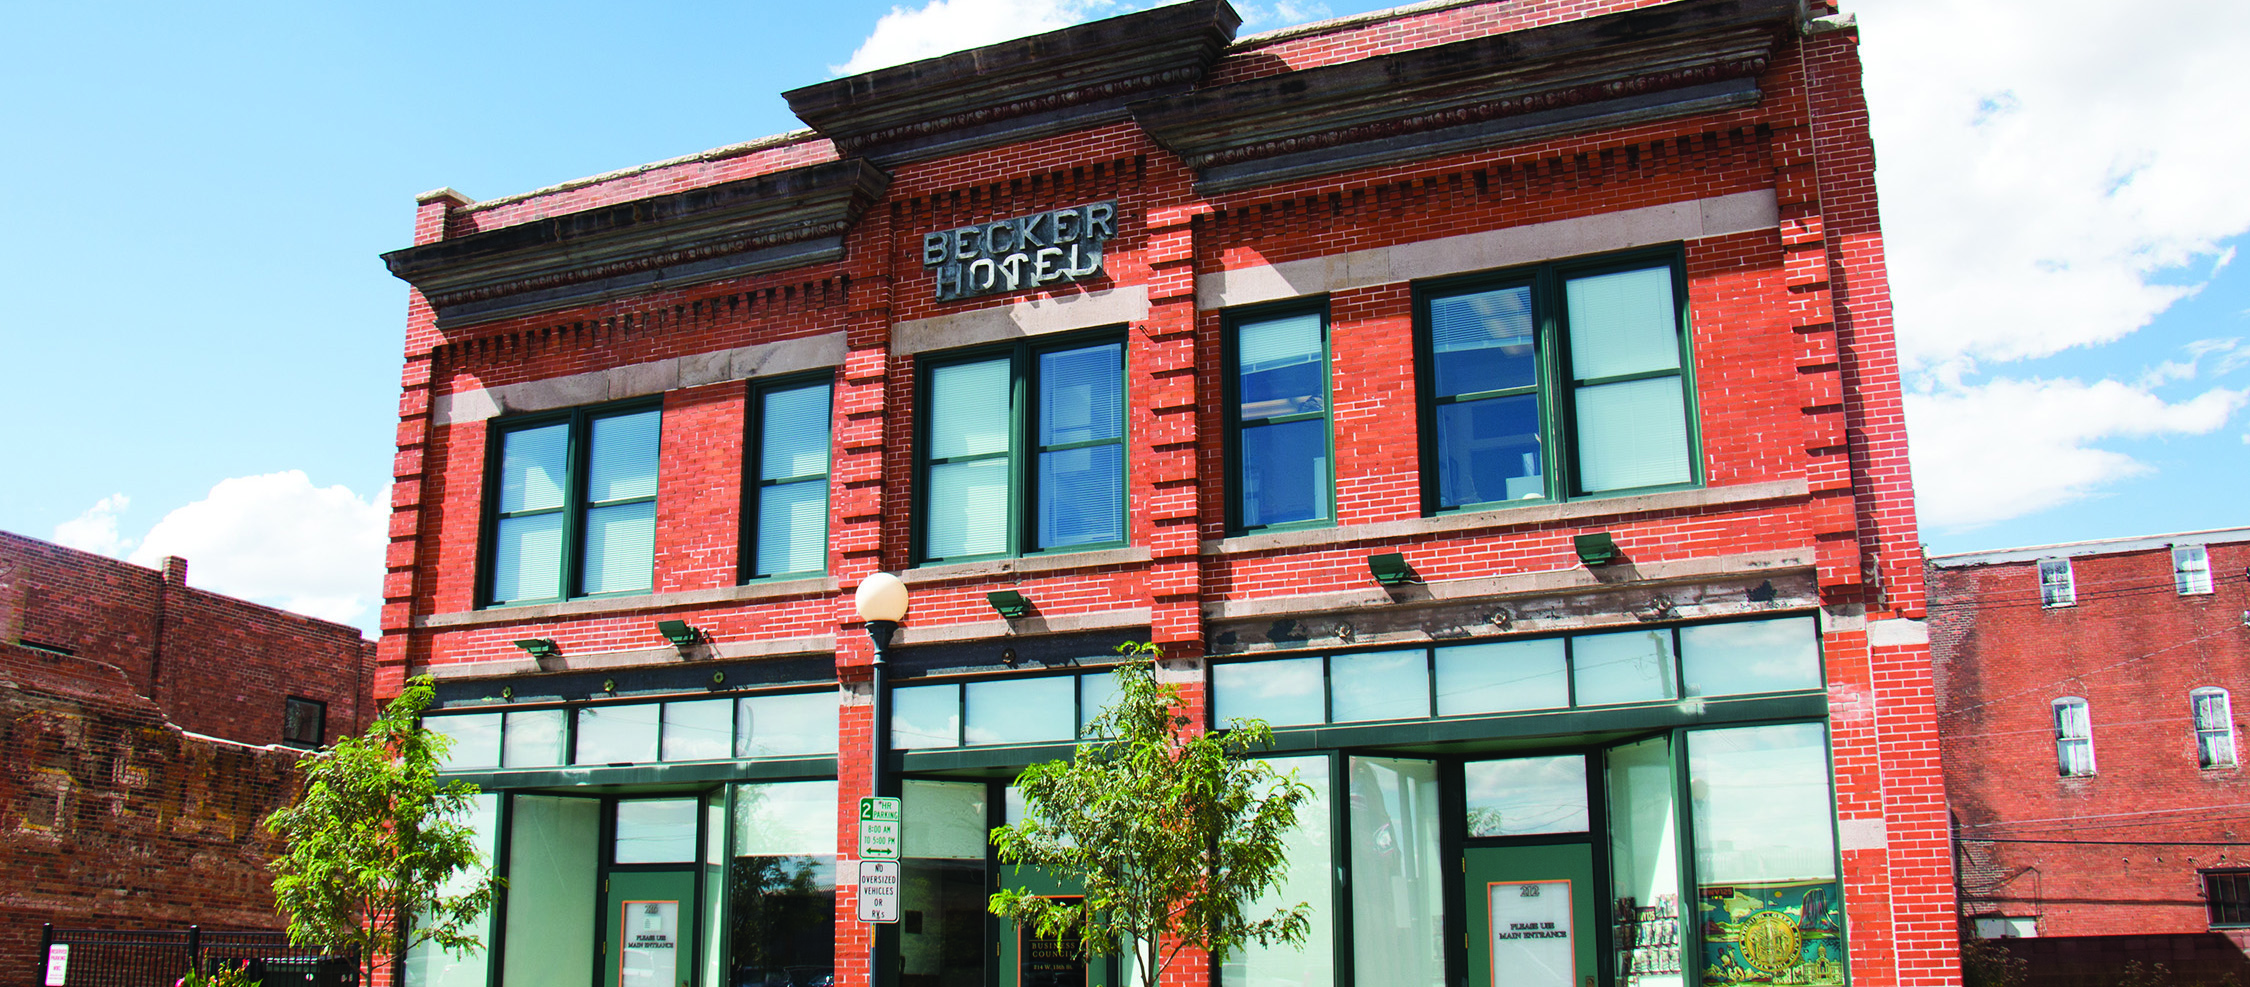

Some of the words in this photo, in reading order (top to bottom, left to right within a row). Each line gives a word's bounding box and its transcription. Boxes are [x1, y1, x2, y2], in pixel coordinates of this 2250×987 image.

[924, 203, 1113, 266] BECKER
[936, 243, 1098, 299] HOTEL
[862, 802, 871, 818] 2
[881, 802, 892, 810] HR
[873, 811, 898, 819] PARKING
[868, 825, 881, 833] 8:00
[883, 825, 891, 833] AM
[864, 836, 871, 844] TO
[872, 836, 886, 844] 5:00
[887, 836, 896, 844] PM
[874, 864, 884, 872] NO
[861, 875, 896, 884] OVERSIZED
[863, 887, 894, 895] VEHICLES
[1520, 884, 1540, 897] 212
[874, 898, 883, 907] OR
[1499, 932, 1521, 940] MAIN
[1523, 931, 1567, 939] ENTRANCE
[1032, 950, 1072, 958] COUNCIL
